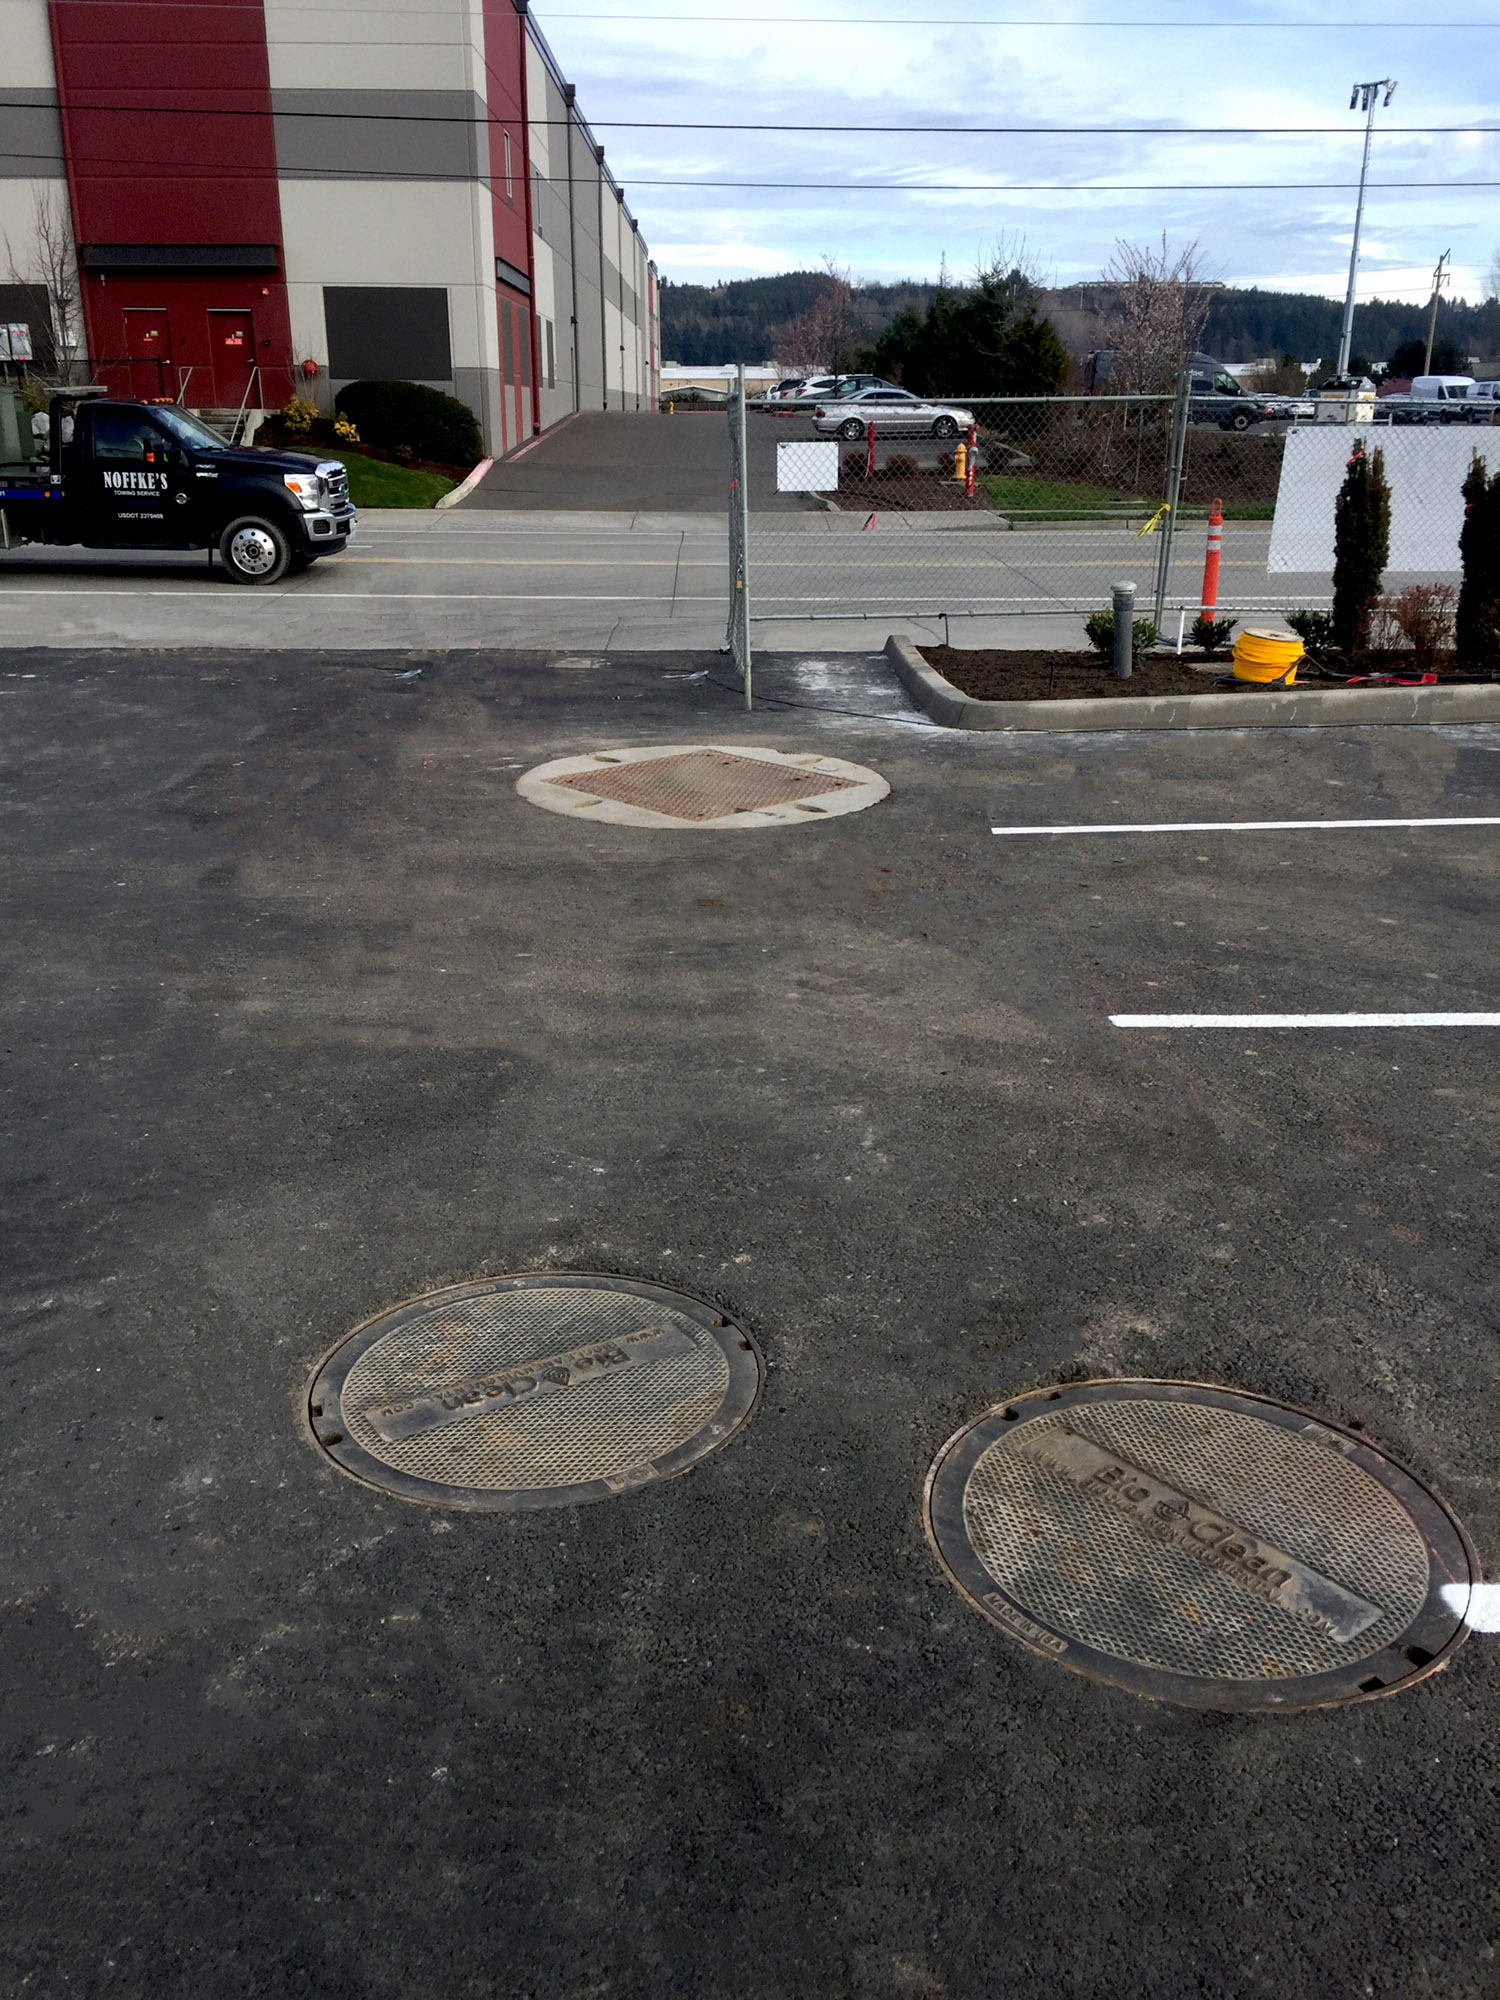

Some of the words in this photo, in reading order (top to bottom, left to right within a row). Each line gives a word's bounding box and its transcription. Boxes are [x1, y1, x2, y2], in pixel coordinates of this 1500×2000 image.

[103, 471, 168, 490] NOFFKE'S
[1095, 1465, 1150, 1501] Bio
[1189, 1521, 1293, 1589] Clean
[988, 1595, 1020, 1622] MADE
[1019, 1620, 1035, 1632] IN
[1035, 1630, 1062, 1650] USA
